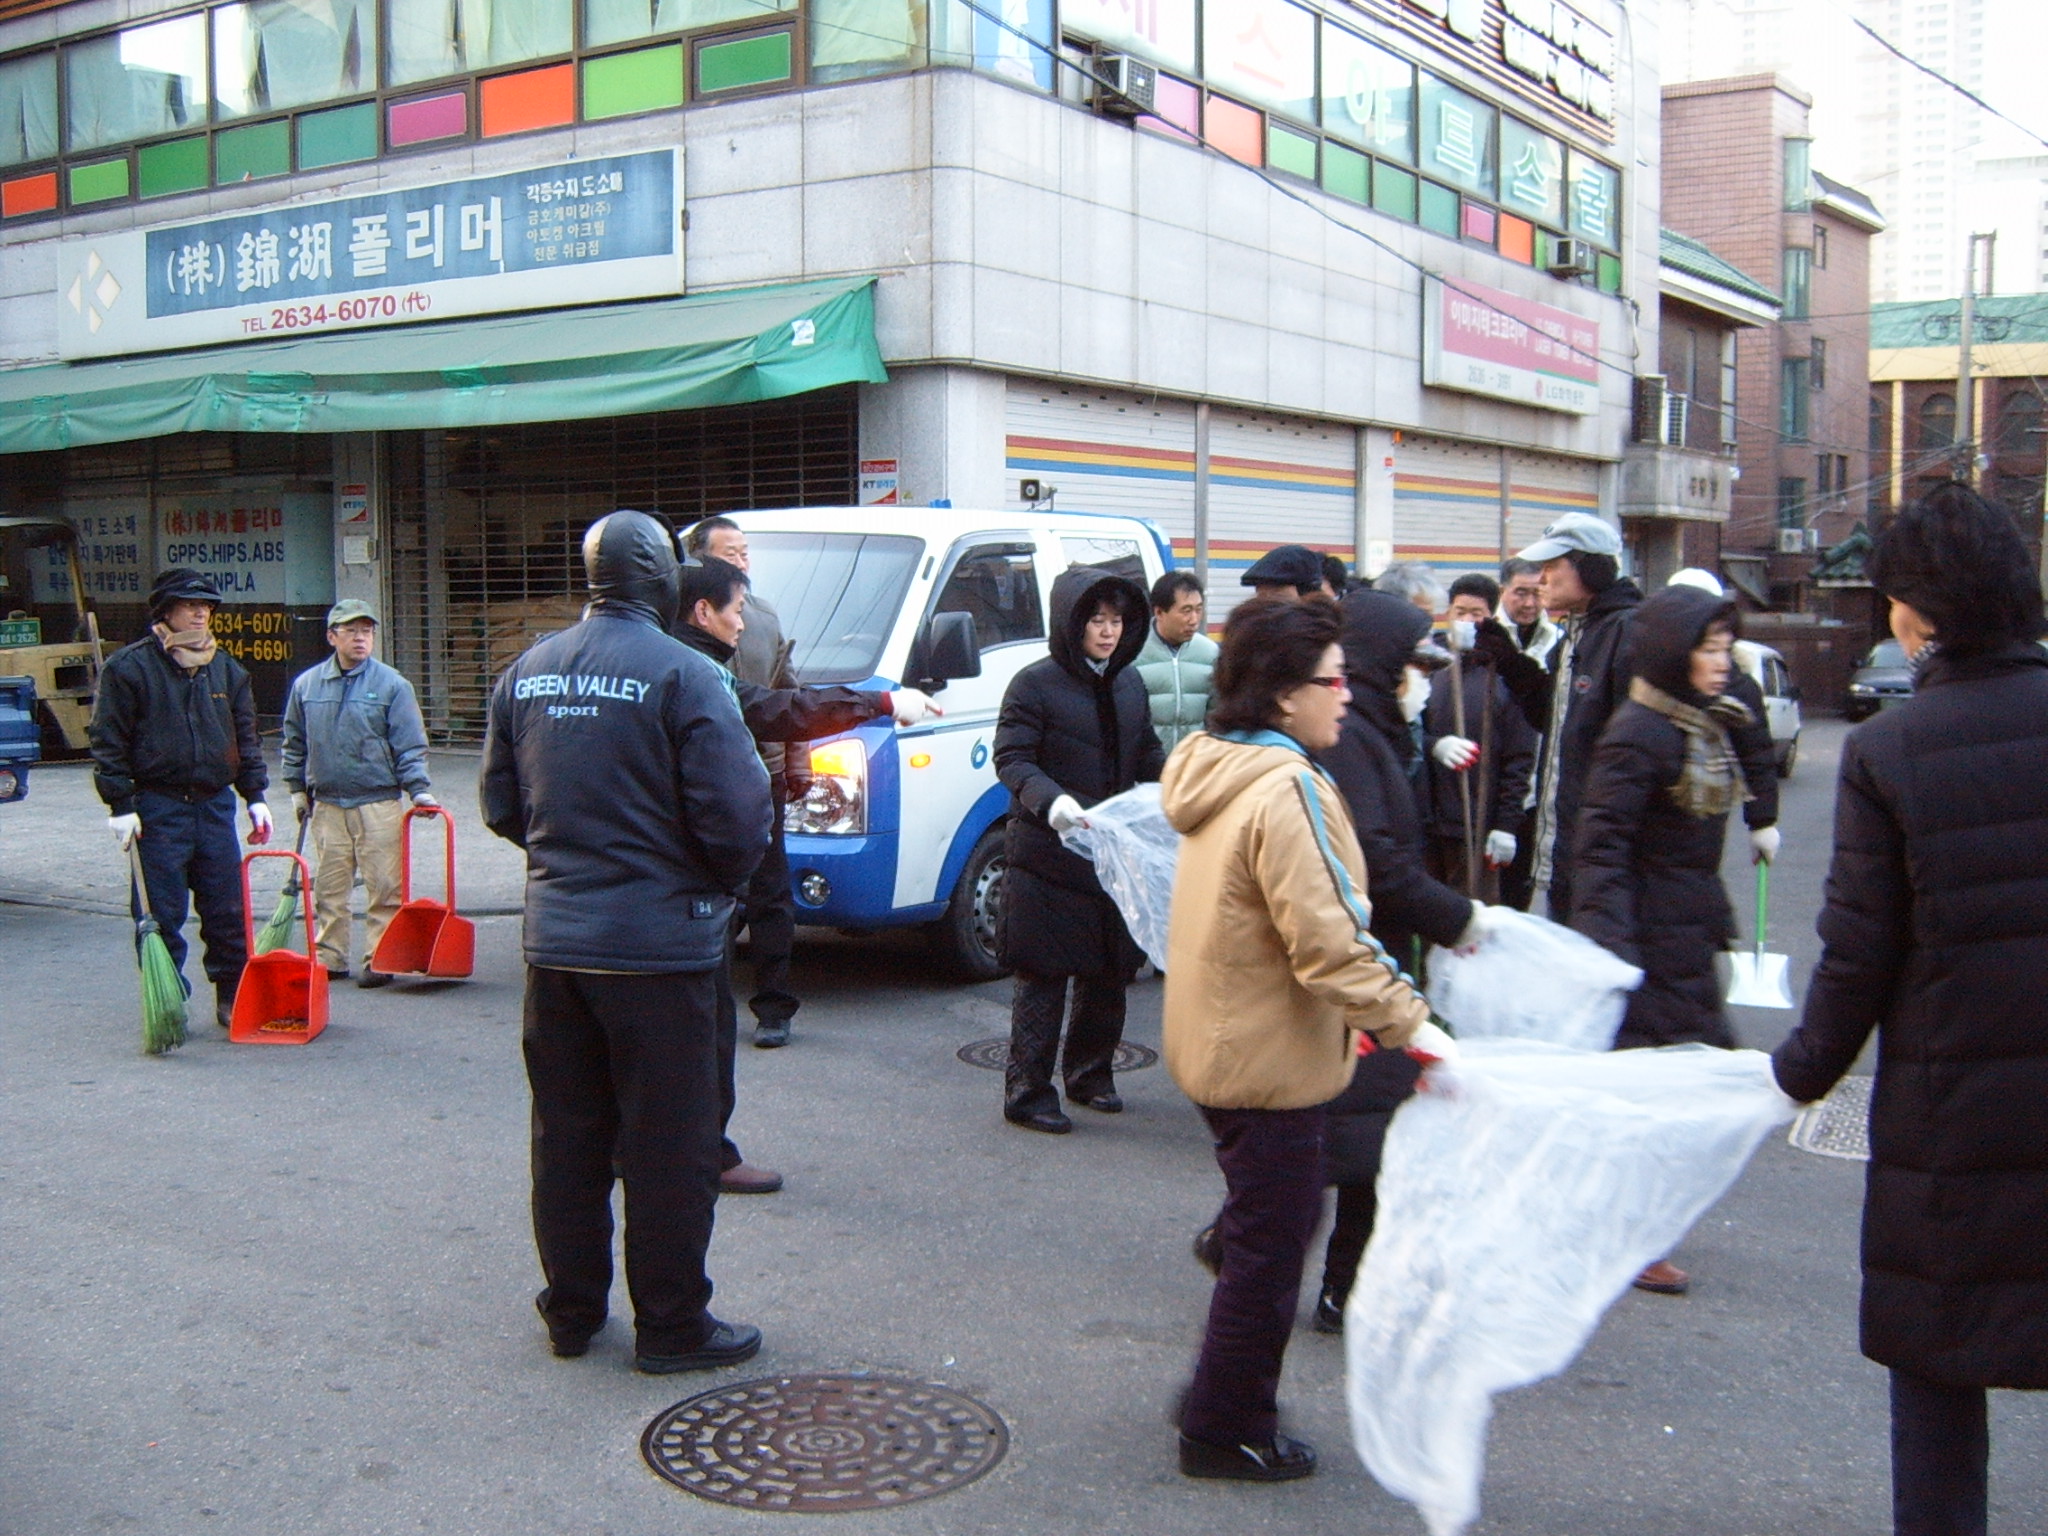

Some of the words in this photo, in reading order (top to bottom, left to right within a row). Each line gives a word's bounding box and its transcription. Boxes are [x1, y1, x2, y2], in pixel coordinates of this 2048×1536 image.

[534, 245, 558, 262] 전문
[562, 240, 600, 258] 취급점
[242, 319, 267, 333] TEL
[271, 295, 397, 330] 2634-6070
[515, 674, 570, 700] GREEN
[577, 675, 651, 703] VALLEY
[548, 705, 599, 719] sport
